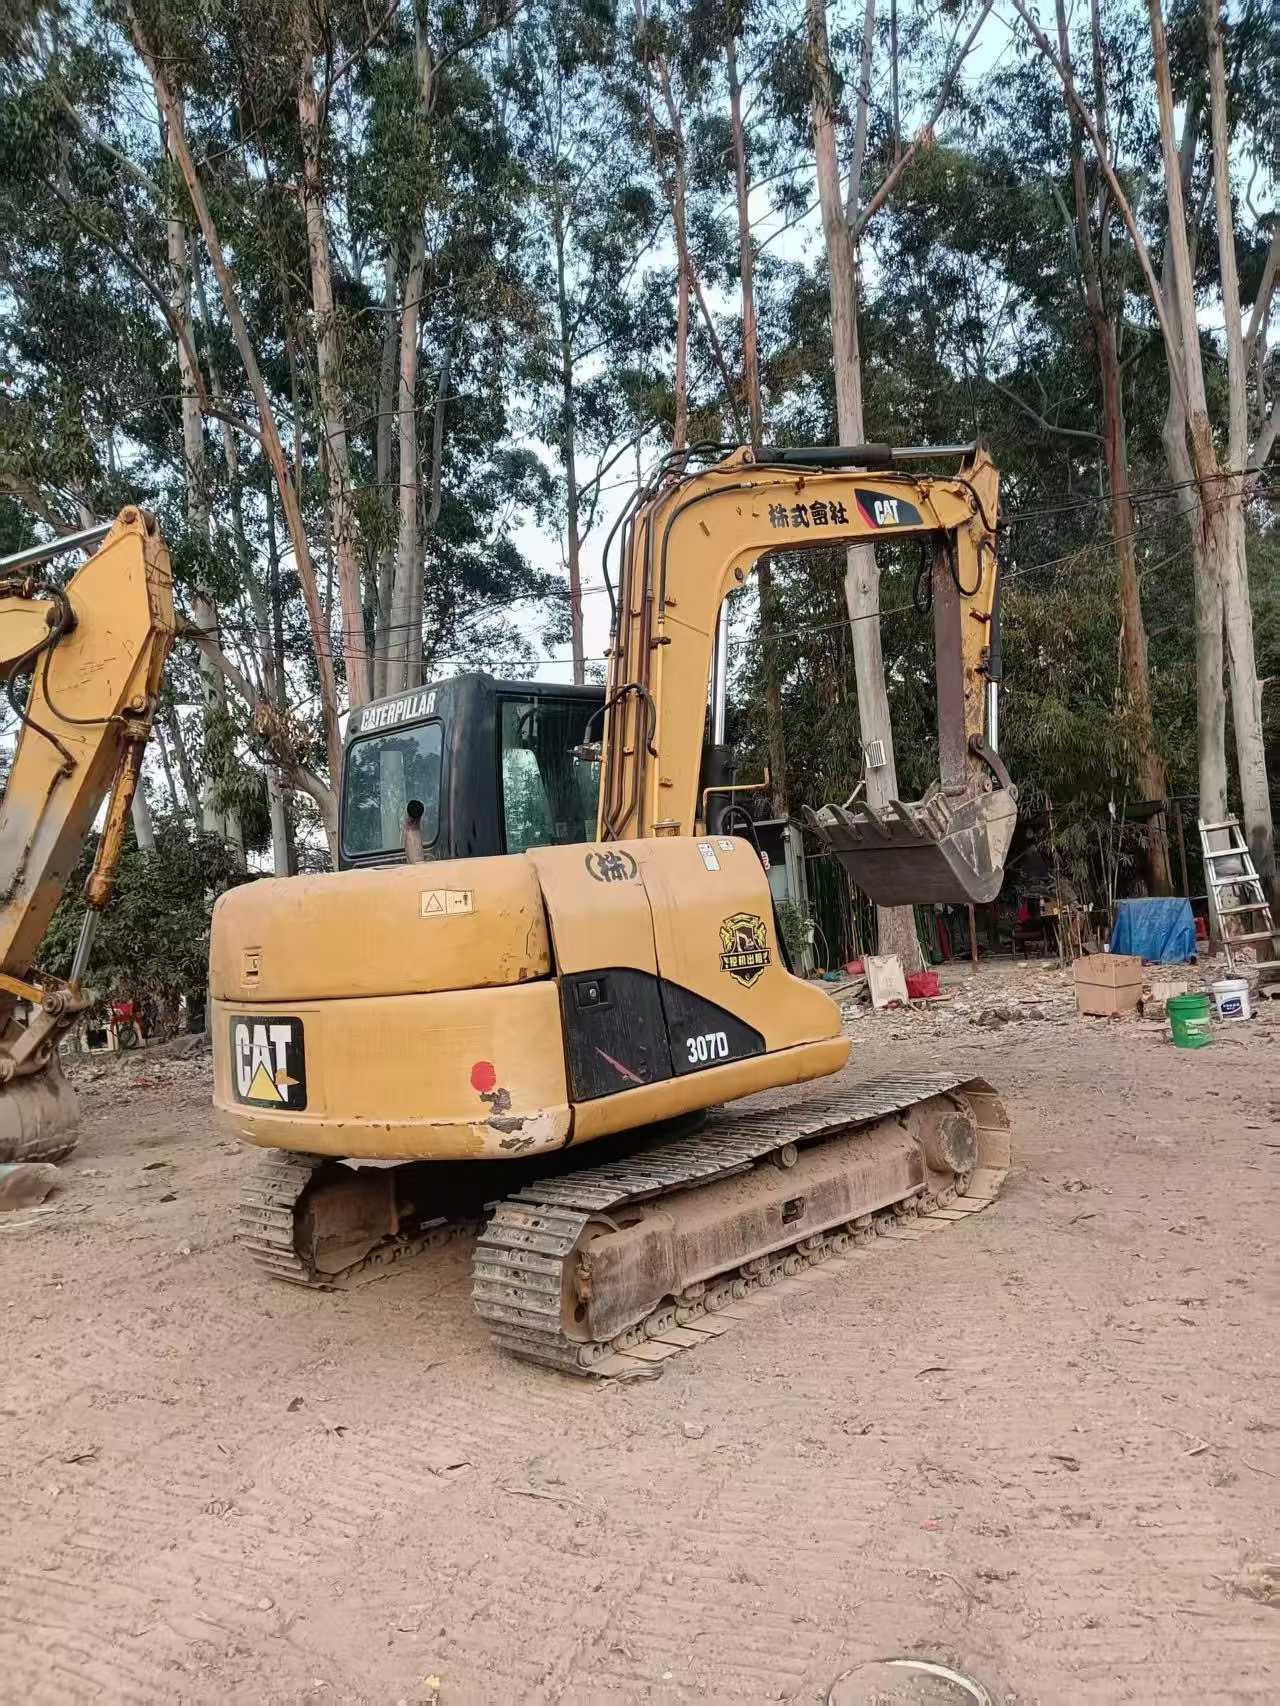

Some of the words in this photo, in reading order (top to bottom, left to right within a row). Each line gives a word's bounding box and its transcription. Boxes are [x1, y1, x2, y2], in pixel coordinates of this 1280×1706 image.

[874, 499, 899, 526] CAT
[360, 691, 437, 732] CATERPILLAR
[235, 1023, 292, 1103] CAT
[686, 1031, 728, 1063] 307D
